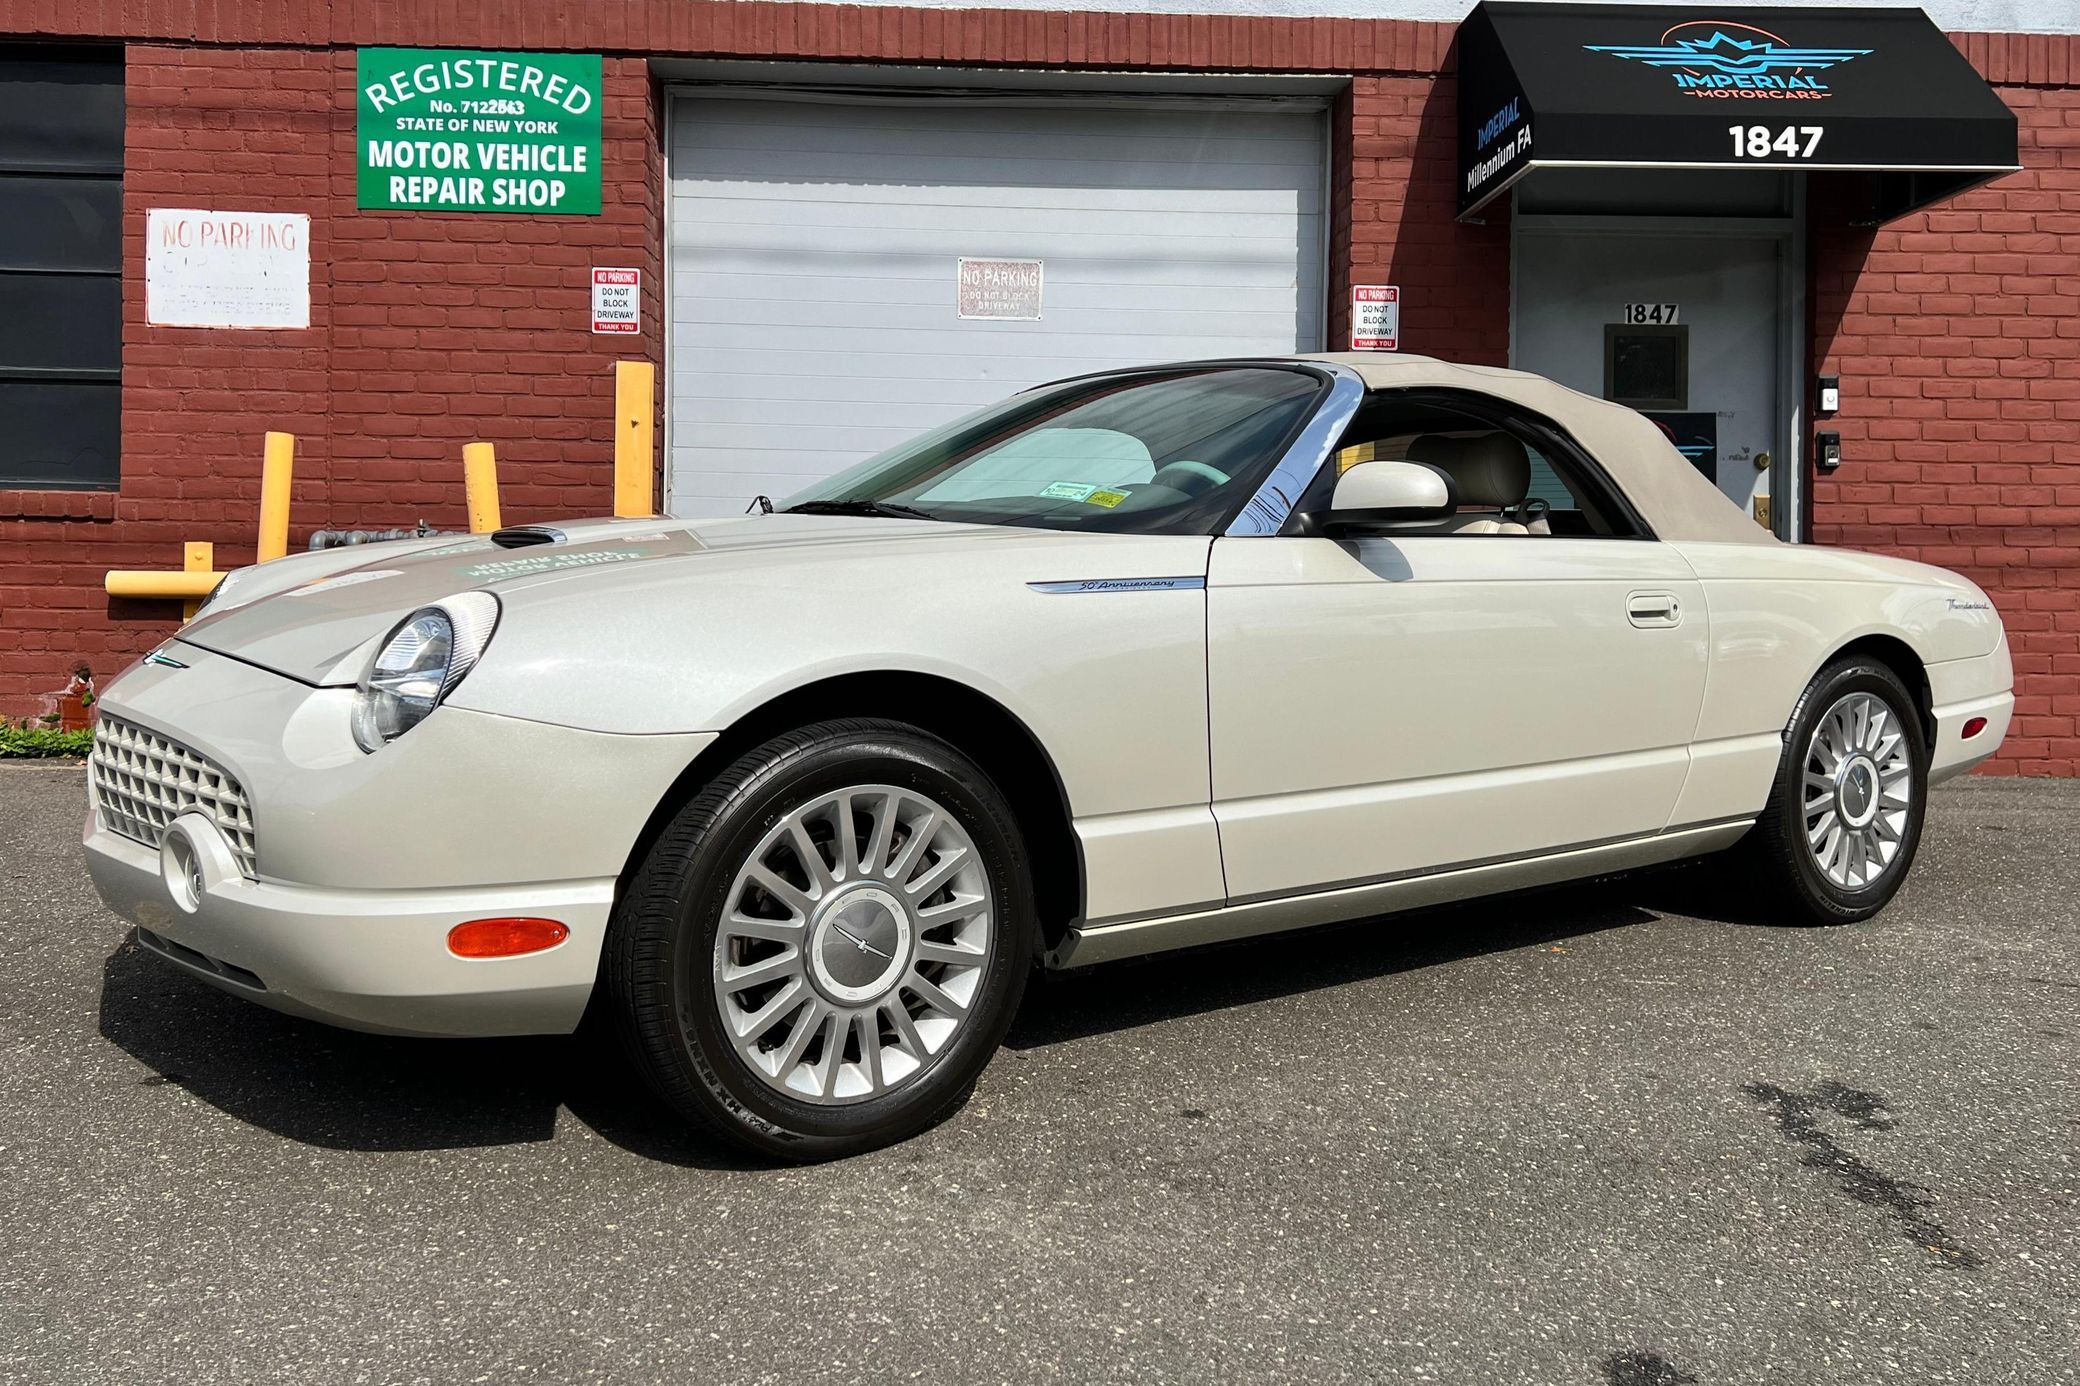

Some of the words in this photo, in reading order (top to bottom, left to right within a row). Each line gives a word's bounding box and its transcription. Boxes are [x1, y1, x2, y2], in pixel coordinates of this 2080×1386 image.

[365, 59, 591, 115] REGISTERED
[1672, 73, 1829, 89] IMPERIAL
[1695, 89, 1822, 99] MOTORCARS
[430, 99, 457, 113] No.
[396, 117, 444, 131] STATE
[448, 118, 469, 132] OF
[473, 119, 510, 133] NEW
[514, 120, 558, 135] YORK
[1478, 96, 1520, 150] IMPERIAL
[1728, 125, 1824, 158] 1847
[368, 140, 470, 169] MOTOR
[477, 143, 587, 173] VEHICLE
[1467, 141, 1515, 192] Millennium
[1517, 124, 1532, 154] FA
[390, 175, 485, 205] REPAIR
[492, 178, 566, 207] SHOP
[163, 220, 193, 248] NO
[597, 272, 607, 283] NO
[608, 272, 635, 284] PARKING
[963, 270, 980, 285] NO
[984, 271, 1037, 287] PARKING
[602, 288, 613, 296] DO
[614, 288, 629, 296] NOT
[1358, 290, 1367, 300] NO
[1368, 290, 1394, 300] PARKING
[603, 299, 628, 307] BLOCK
[1362, 305, 1373, 313] DO
[1374, 305, 1388, 313] NOT
[597, 311, 634, 319] DRIVEWAY
[1363, 316, 1387, 324] BLOCK
[1625, 304, 1678, 324] 1847
[598, 323, 619, 331] THANK
[621, 323, 634, 331] YOU
